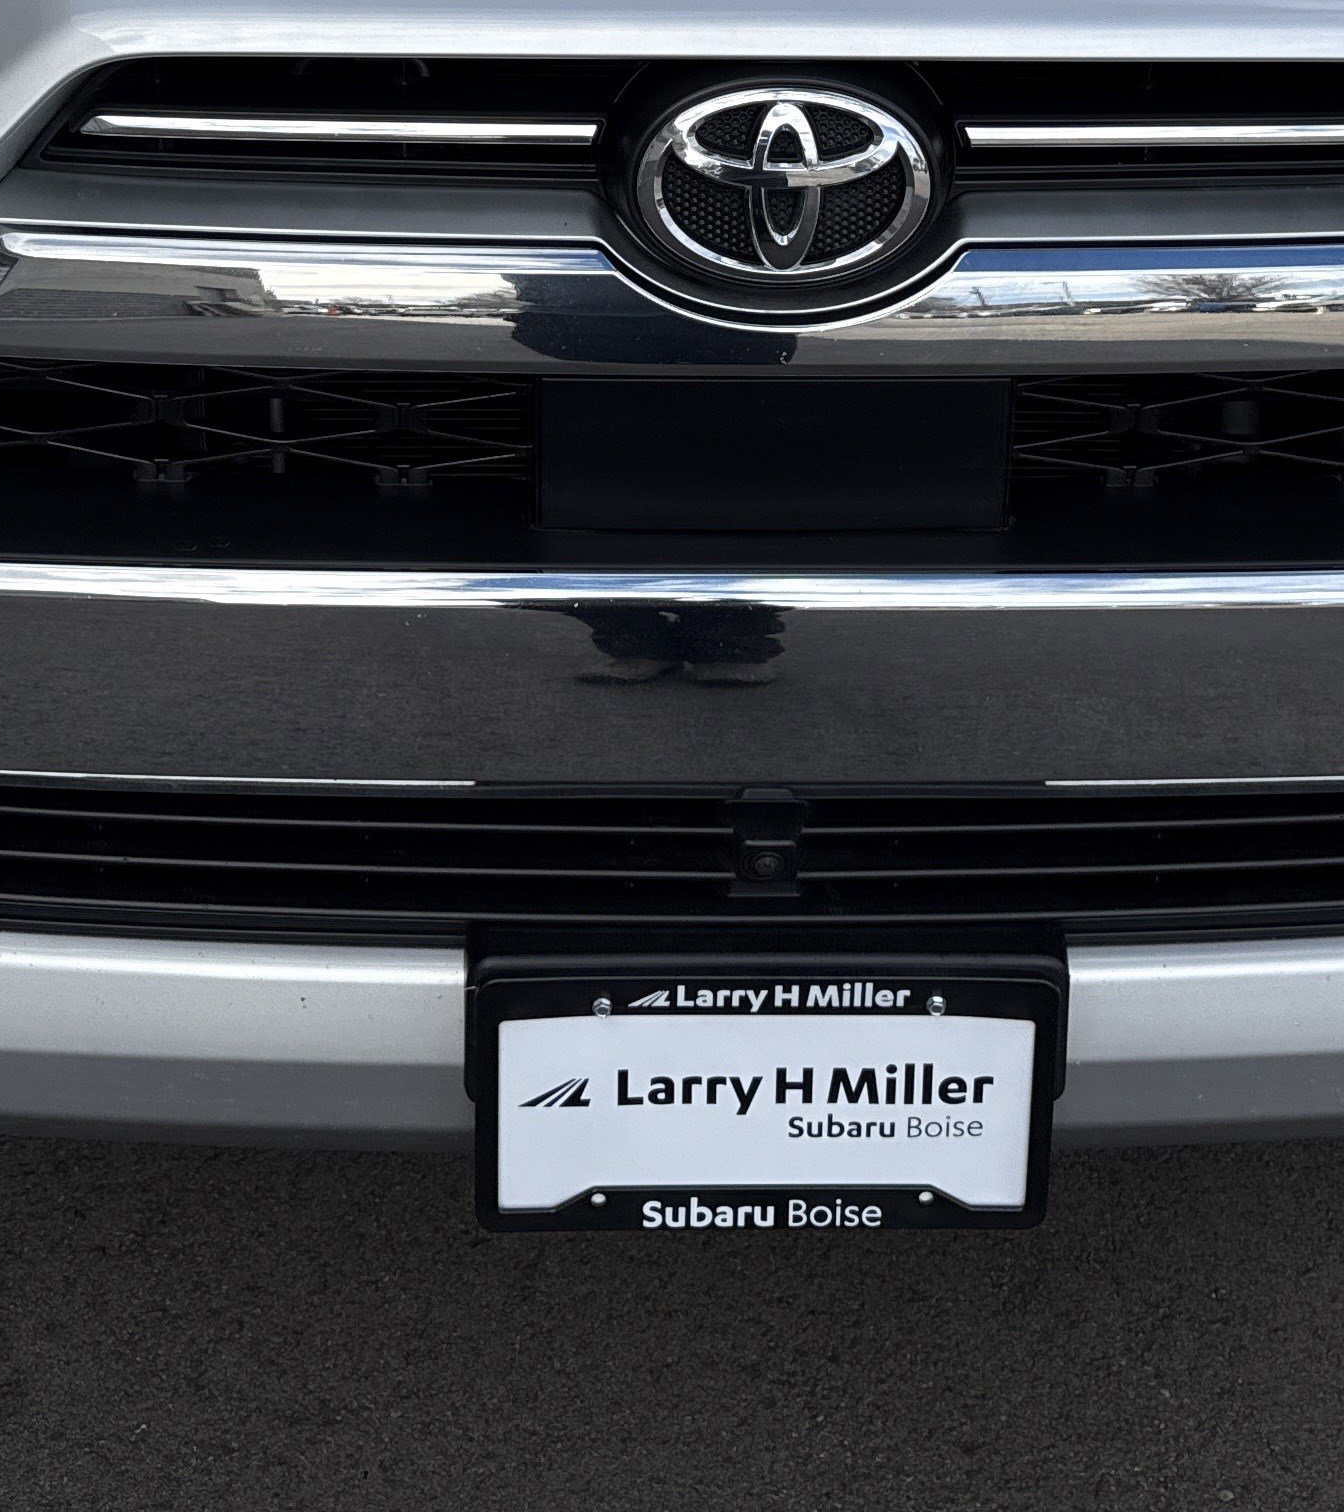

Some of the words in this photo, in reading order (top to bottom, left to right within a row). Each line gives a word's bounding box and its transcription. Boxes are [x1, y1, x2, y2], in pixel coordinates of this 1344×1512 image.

[676, 984, 768, 1013] Larry
[774, 984, 800, 1007] H
[805, 982, 911, 1008] Miller
[617, 1069, 764, 1116] Larry
[775, 1067, 814, 1105] H
[826, 1063, 994, 1105] Miller
[788, 1114, 896, 1139] Subaru
[906, 1115, 984, 1139] Boise
[642, 1196, 775, 1228] Subaru
[788, 1198, 882, 1227] Boise
